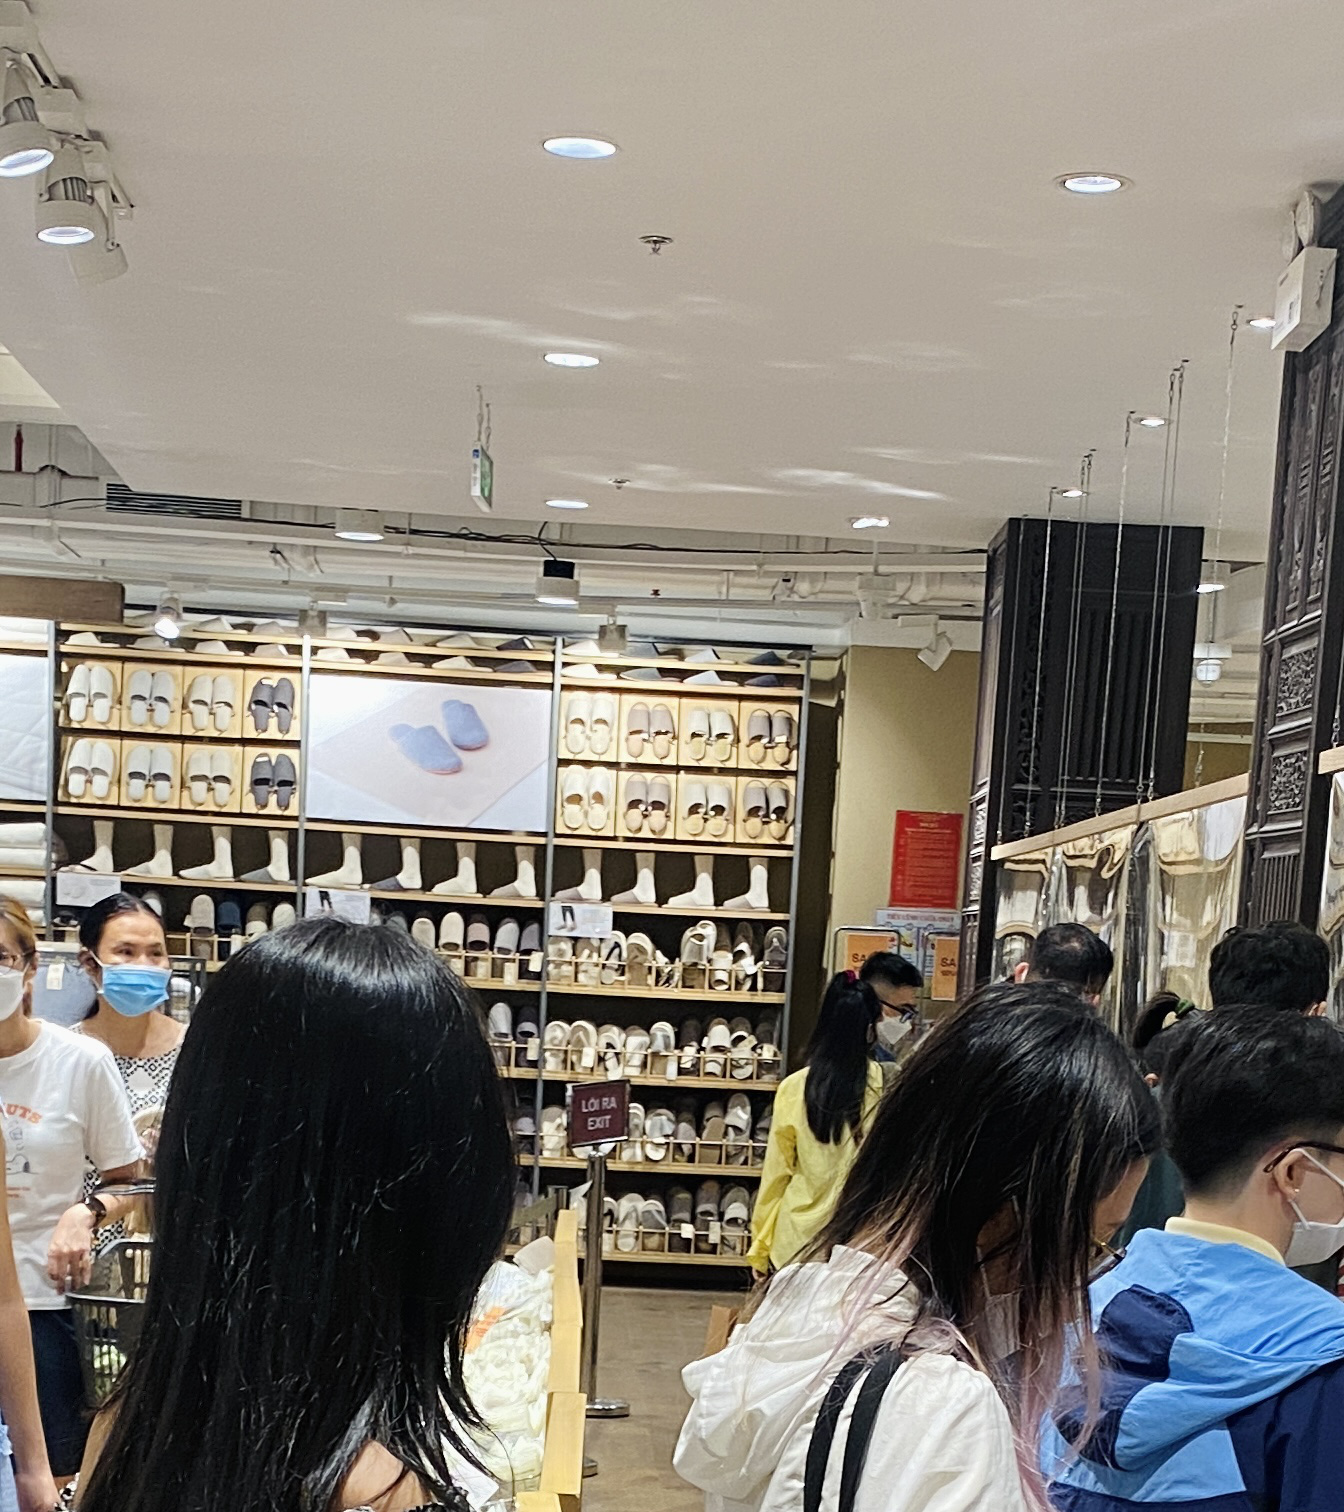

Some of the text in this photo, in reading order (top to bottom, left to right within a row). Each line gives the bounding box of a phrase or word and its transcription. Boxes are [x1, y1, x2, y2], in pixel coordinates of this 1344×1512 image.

[852, 953, 867, 963] SA
[940, 957, 957, 968] SA
[601, 1096, 618, 1110] RA
[6, 1103, 42, 1124] UTS
[587, 1115, 612, 1131] EXIT
